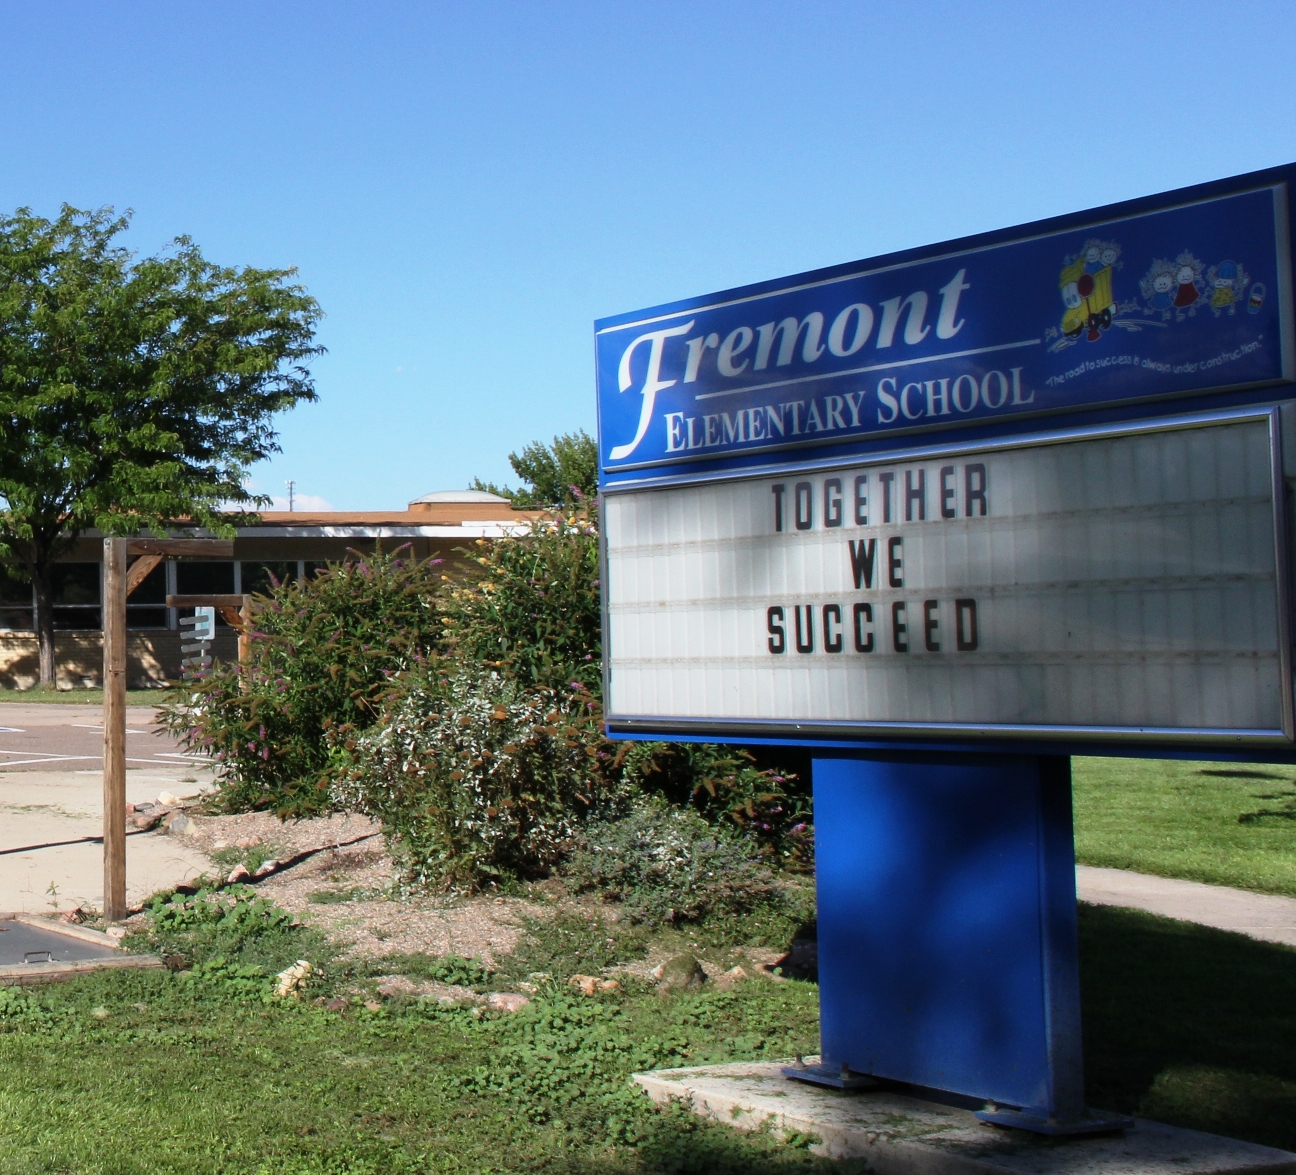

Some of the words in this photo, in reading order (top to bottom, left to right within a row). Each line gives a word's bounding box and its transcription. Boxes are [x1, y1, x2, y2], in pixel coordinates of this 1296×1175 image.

[609, 268, 971, 460] Fremont
[1065, 362, 1085, 379] road
[1085, 359, 1095, 370] to
[1095, 355, 1132, 367] success
[1133, 354, 1140, 366] is
[1141, 358, 1172, 374] always
[1172, 362, 1198, 374] under
[664, 390, 867, 453] ELEMENTARY
[876, 366, 1036, 424] SCHOOL
[771, 463, 988, 532] TOGETHER
[848, 536, 903, 589] WE
[767, 598, 979, 654] SUCCEED
